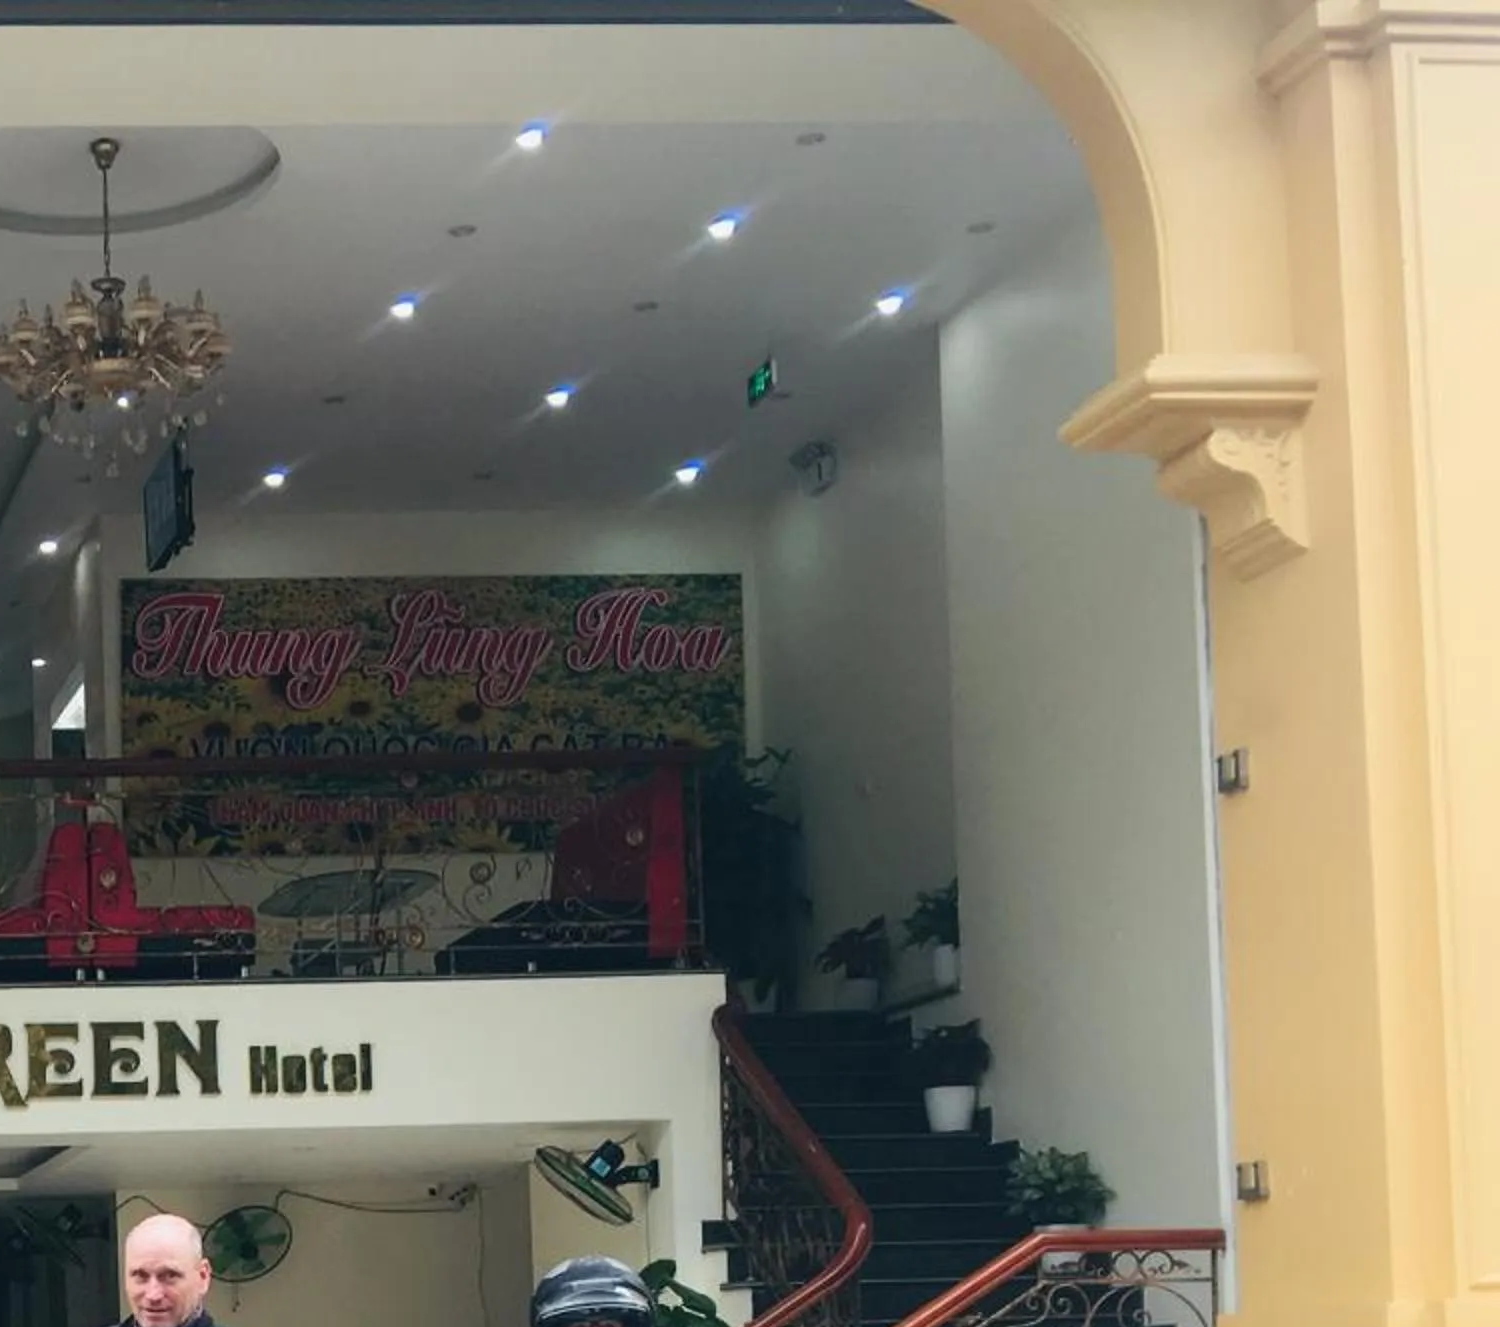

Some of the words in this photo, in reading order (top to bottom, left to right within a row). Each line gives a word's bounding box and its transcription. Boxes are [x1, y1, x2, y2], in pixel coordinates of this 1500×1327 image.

[132, 592, 363, 710] Thung
[568, 586, 732, 674] Hoa
[248, 1043, 374, 1095] Hotel
